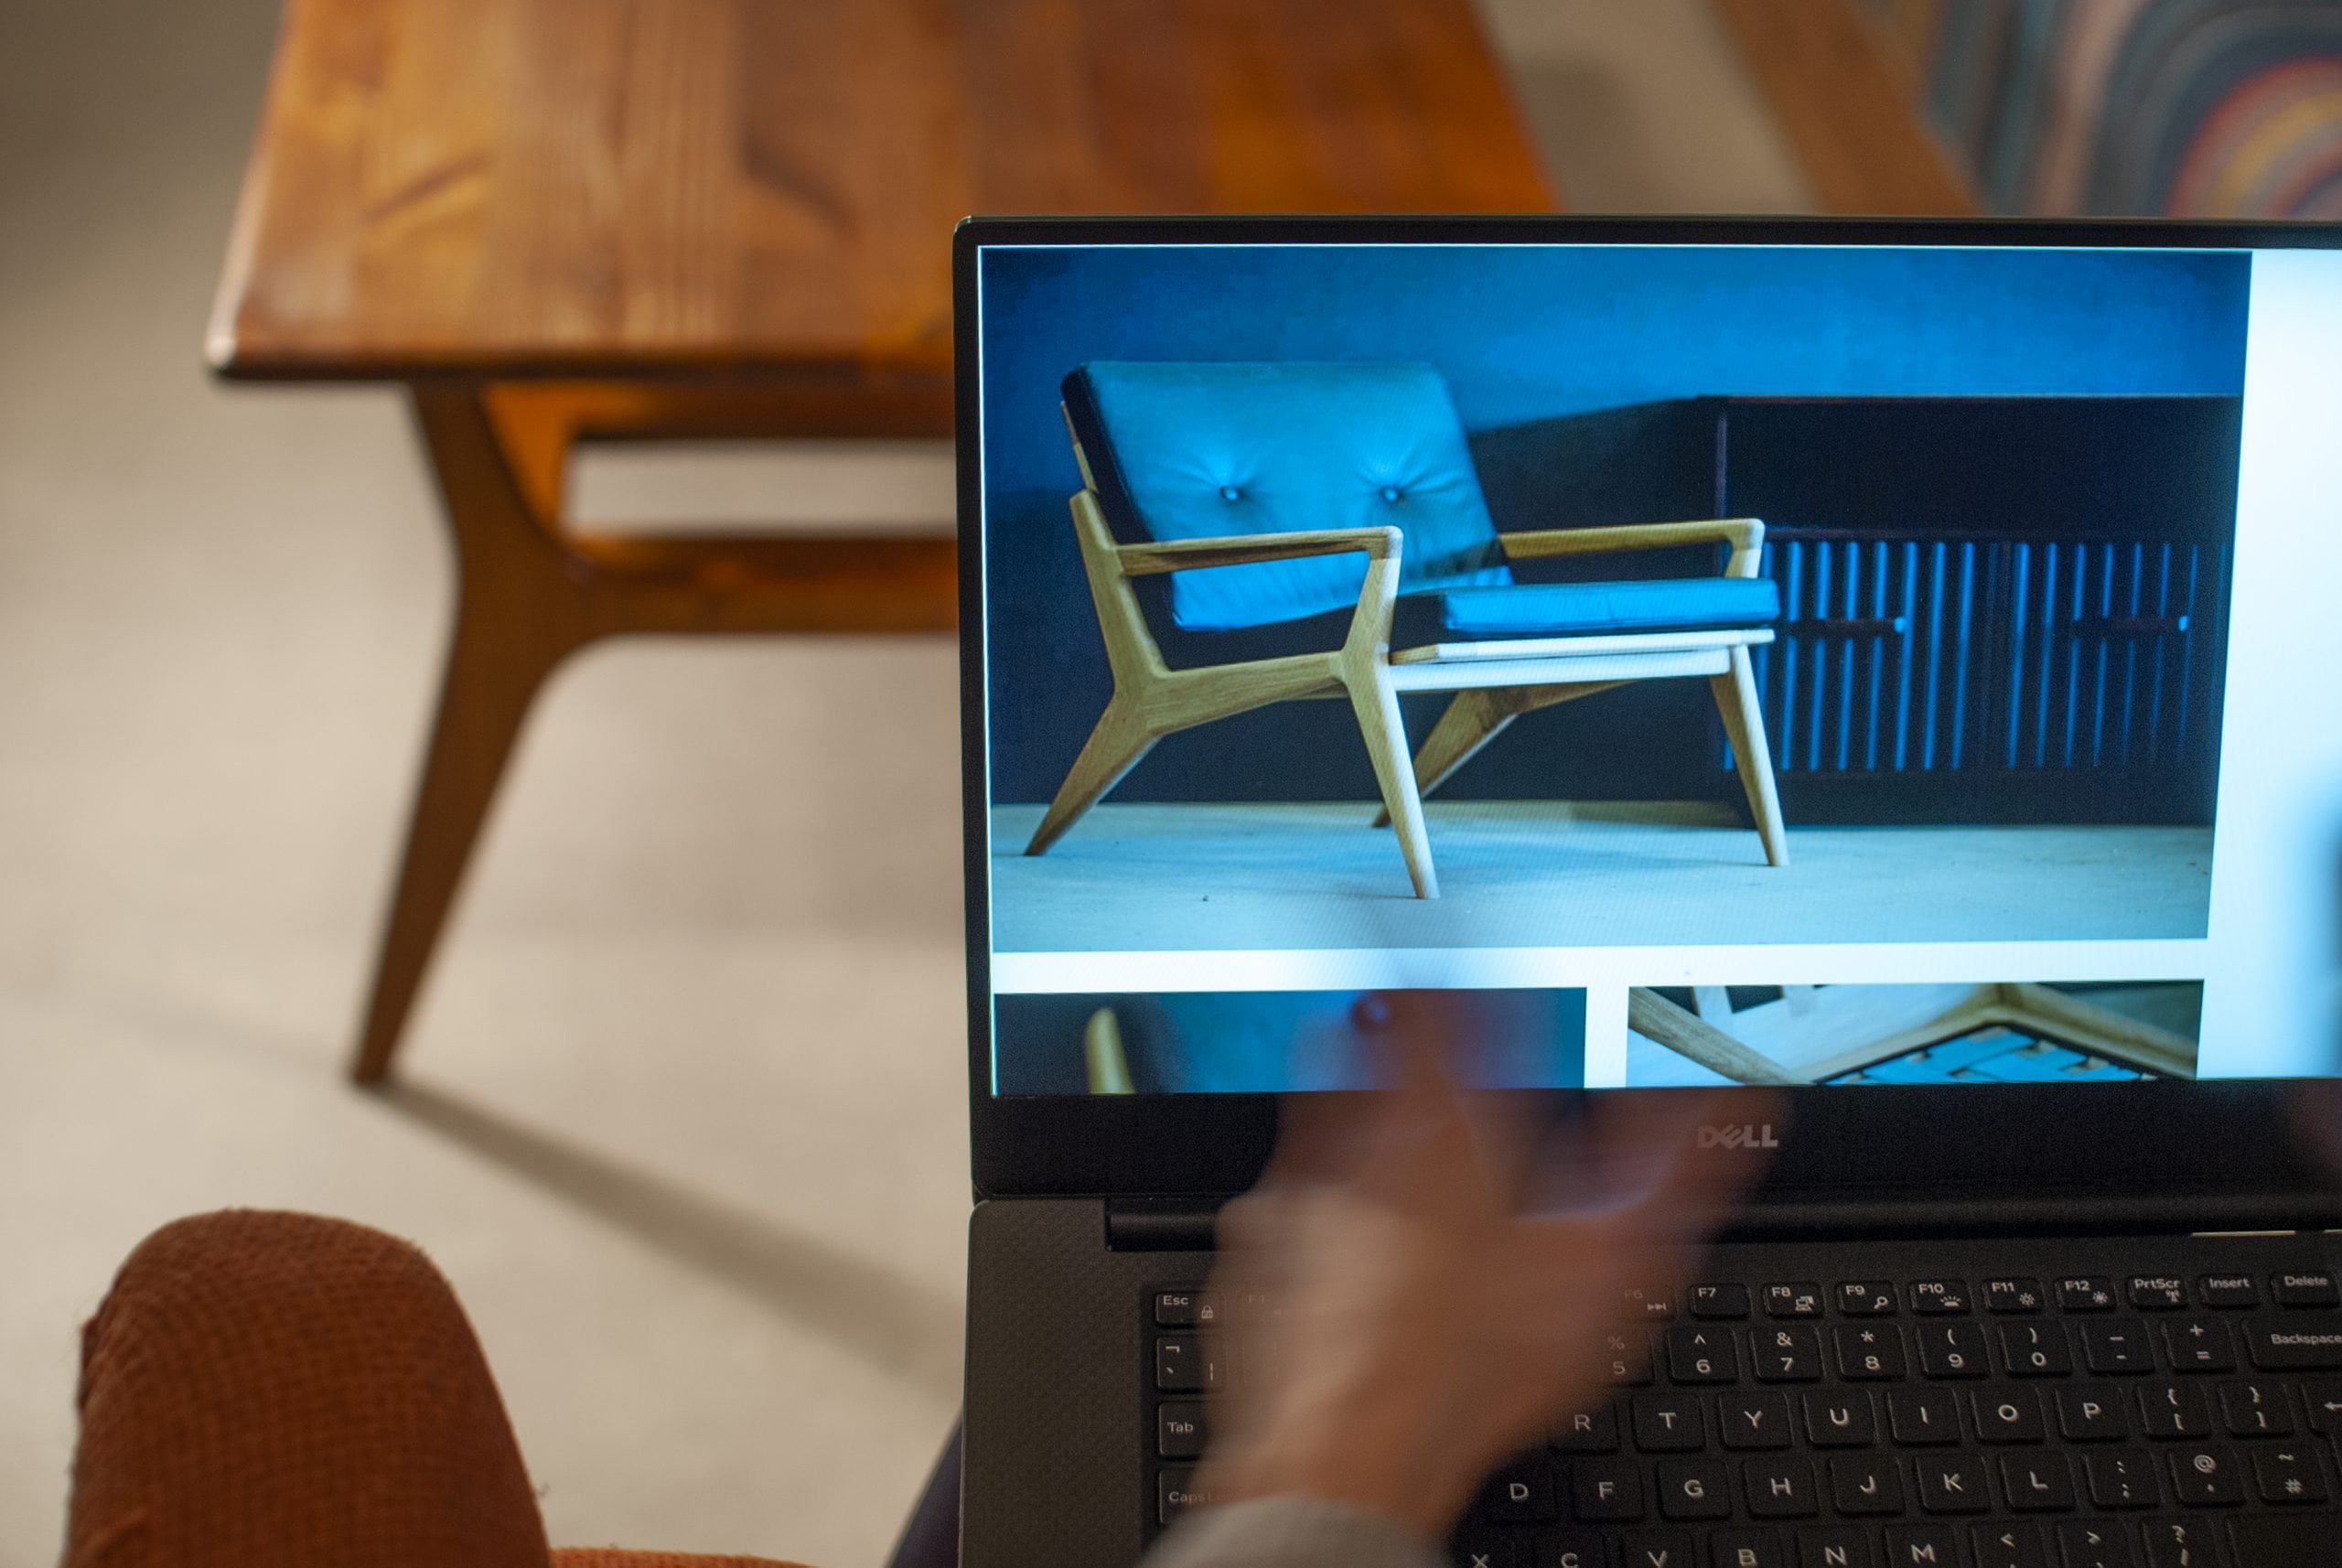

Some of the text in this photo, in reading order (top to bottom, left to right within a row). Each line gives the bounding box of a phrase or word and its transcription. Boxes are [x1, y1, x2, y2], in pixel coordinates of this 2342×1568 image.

[1697, 1123, 1778, 1149] DELL
[1918, 1283, 1944, 1294] F10
[1992, 1282, 2015, 1293] F11
[2064, 1281, 2091, 1292] F12
[2133, 1278, 2181, 1290] PrtScr
[2208, 1277, 2251, 1288] Insert
[2283, 1275, 2328, 1287] Delete
[1624, 1289, 1643, 1299] F6
[1698, 1287, 1716, 1297] F7
[1771, 1287, 1791, 1298] F8
[1845, 1285, 1866, 1296] F9
[1163, 1294, 1188, 1305] Esc
[1947, 1328, 1956, 1346] (
[2029, 1327, 2038, 1344] )
[2189, 1324, 2205, 1337] +
[1607, 1336, 1626, 1349] %
[1777, 1332, 1793, 1347] &
[2270, 1333, 2342, 1346] Backspace
[1948, 1353, 1964, 1369] 9
[2196, 1350, 2211, 1359] =
[1613, 1361, 1626, 1374] 5
[1696, 1359, 1711, 1373] 6
[1780, 1357, 1794, 1371] 7
[1864, 1356, 1881, 1370] 8
[1830, 1408, 1850, 1426] U
[1920, 1406, 1928, 1424] I
[1998, 1404, 2018, 1423] O
[2082, 1402, 2101, 1420] P
[1574, 1413, 1591, 1432] R
[1658, 1412, 1677, 1429] T
[1744, 1410, 1764, 1429] Y
[1167, 1422, 1194, 1434] Tab
[2194, 1455, 2217, 1474] @
[1770, 1477, 1792, 1497] H
[1859, 1476, 1875, 1494] J
[1942, 1473, 1964, 1493] K
[2029, 1470, 2049, 1490] L
[2285, 1478, 2304, 1494] #
[1509, 1483, 1529, 1500] D
[1598, 1481, 1614, 1500] F
[1684, 1479, 1704, 1498] G
[1168, 1490, 1205, 1504] Caps
[1472, 1554, 1488, 1568] X
[1561, 1552, 1579, 1568] C
[1647, 1551, 1668, 1568] V
[1738, 1548, 1757, 1568] B
[1824, 1546, 1847, 1566] N
[1910, 1543, 1936, 1563] M
